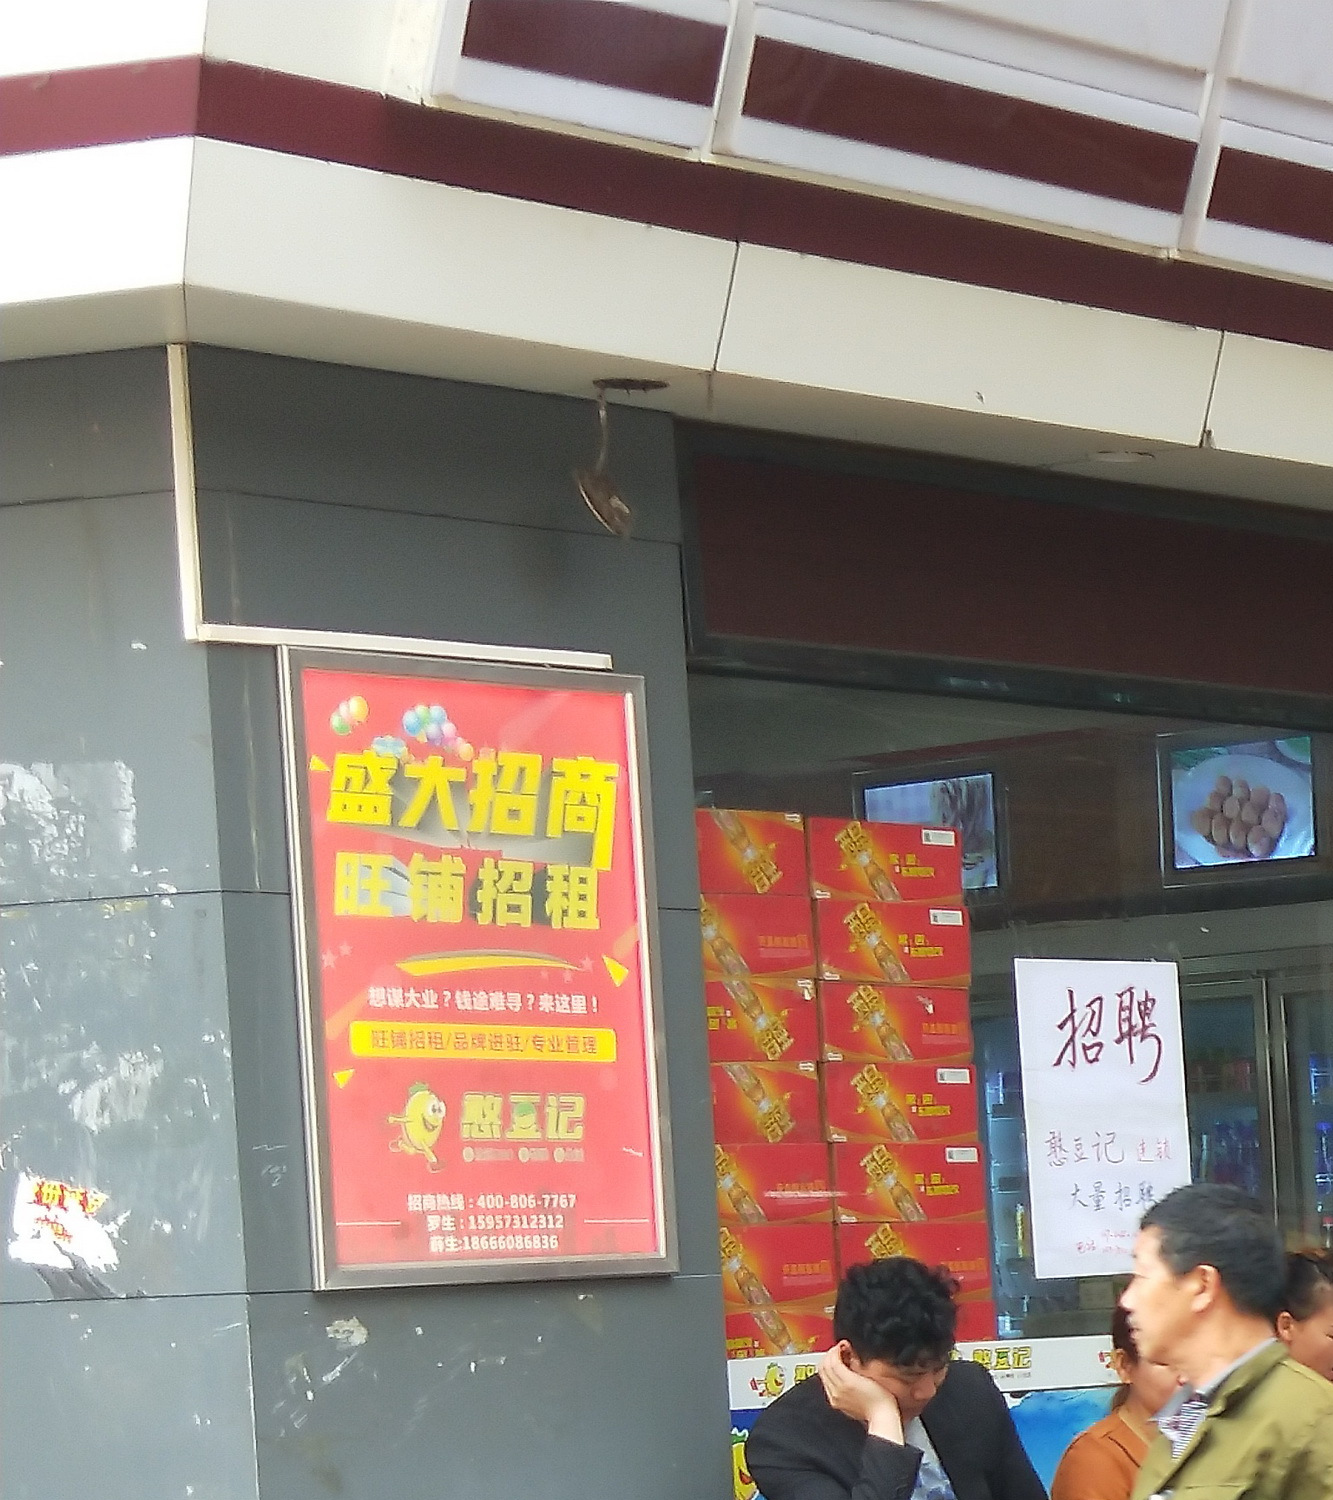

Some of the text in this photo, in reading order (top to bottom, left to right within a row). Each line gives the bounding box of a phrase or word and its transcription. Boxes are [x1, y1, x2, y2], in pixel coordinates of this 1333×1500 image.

[327, 748, 620, 871] 盛大招商
[334, 851, 601, 930] 旺铺招租
[1052, 985, 1164, 1085] 招聘
